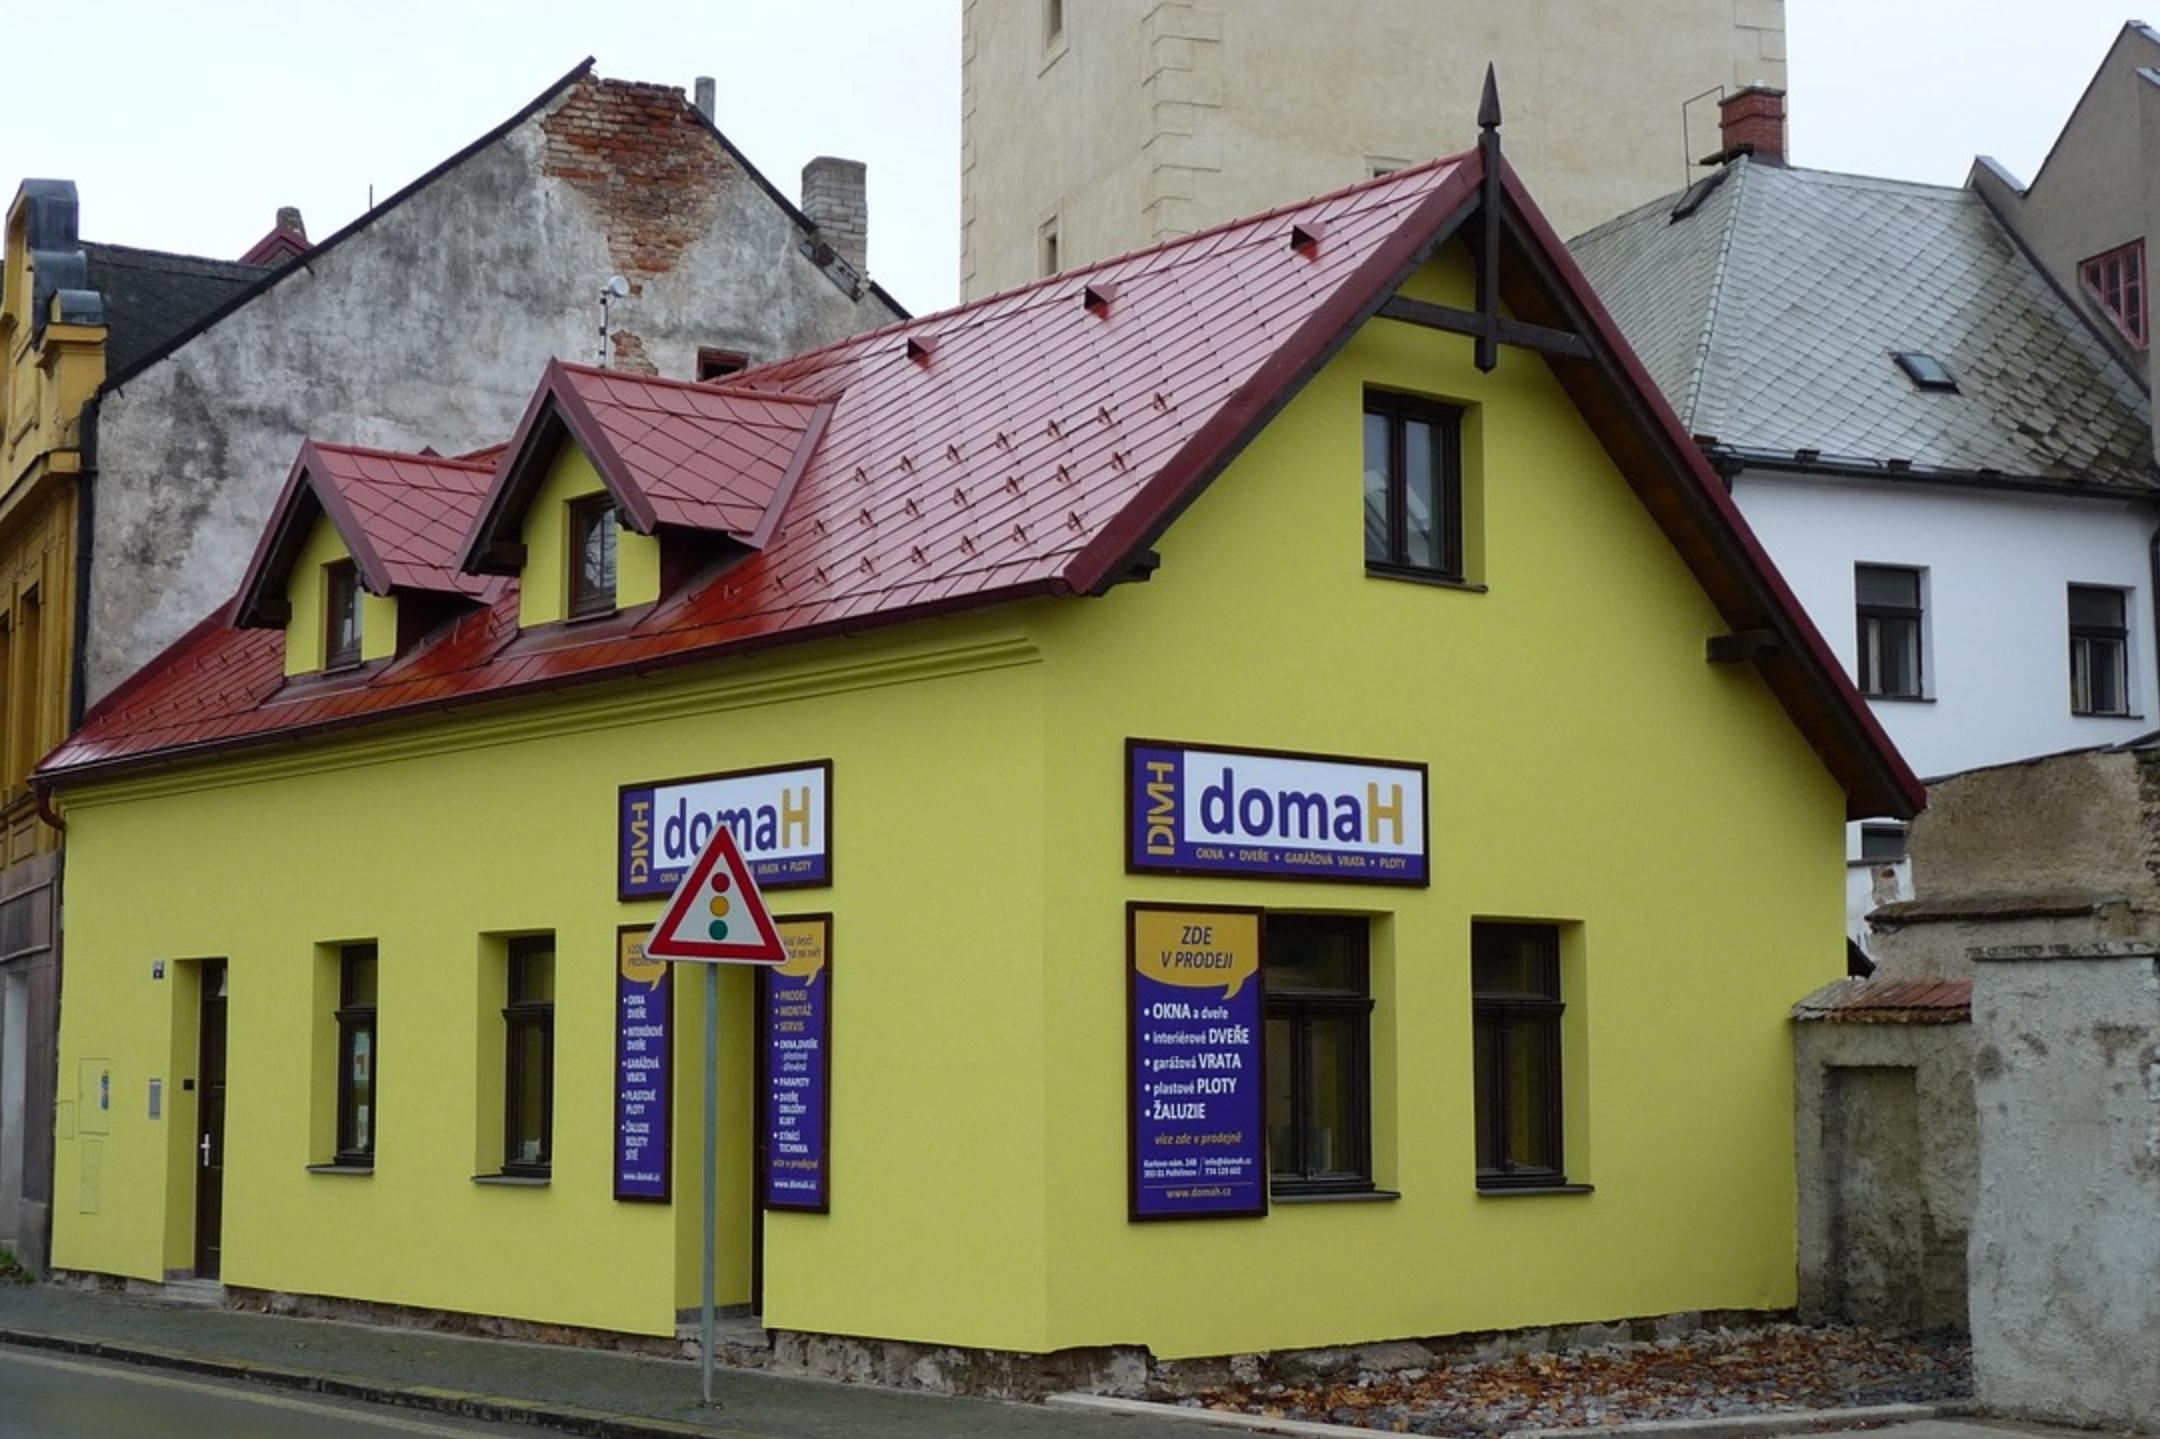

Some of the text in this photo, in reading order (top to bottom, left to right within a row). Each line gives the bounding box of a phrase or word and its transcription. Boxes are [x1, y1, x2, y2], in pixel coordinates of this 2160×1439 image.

[1147, 761, 1175, 856] DMH
[1200, 767, 1404, 845] domaH
[631, 801, 648, 884] DMH
[1195, 848, 1224, 860] OKNA
[1239, 848, 1269, 862] DVEŘE
[1338, 855, 1366, 867] VRATA
[1380, 857, 1406, 869] PLOTY
[1181, 925, 1213, 945] ZDE
[1161, 951, 1233, 969] V PRODEJI
[1153, 1003, 1228, 1019] OKNA a dveře
[1153, 1024, 1249, 1045] interiérové DVEŘE
[1153, 1053, 1242, 1072] garážová VRATA
[1153, 1078, 1237, 1097] plastové PLOTY
[1153, 1100, 1206, 1120] ŽALUZIE
[1166, 1187, 1231, 1198] www.domah.cz
